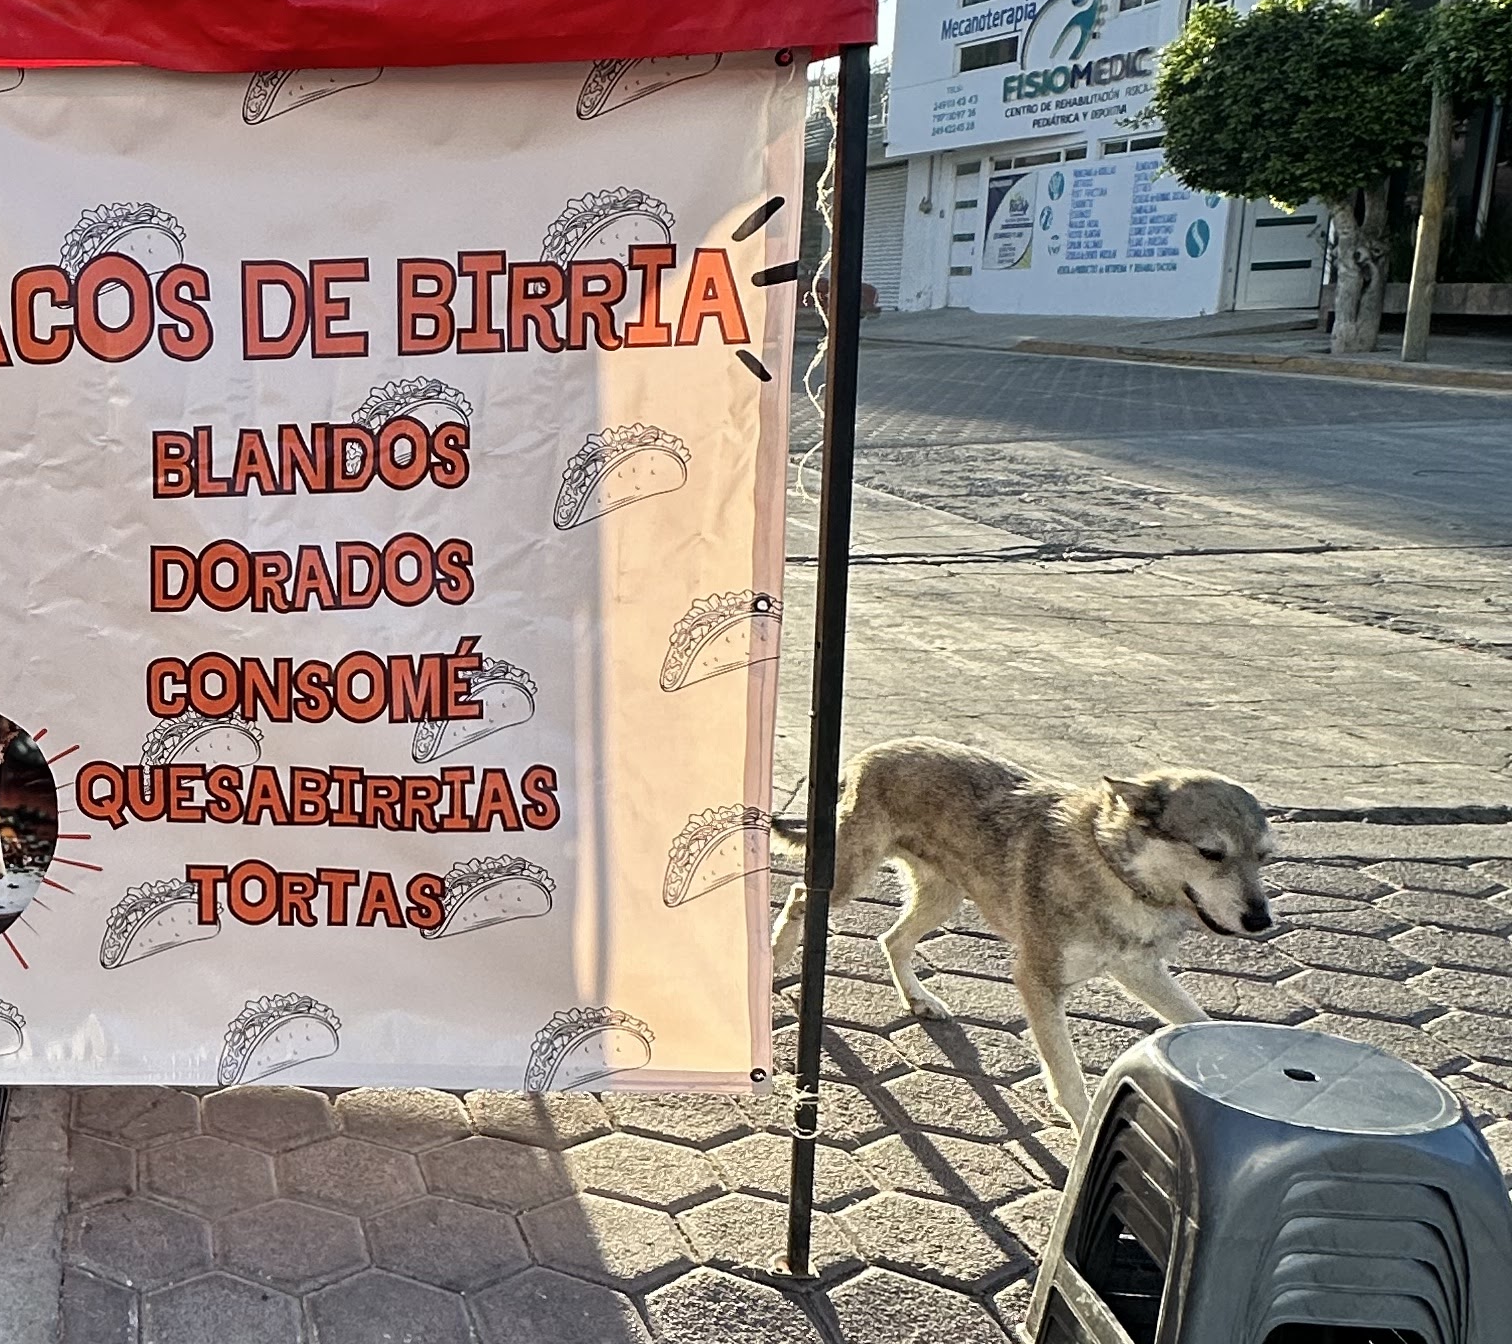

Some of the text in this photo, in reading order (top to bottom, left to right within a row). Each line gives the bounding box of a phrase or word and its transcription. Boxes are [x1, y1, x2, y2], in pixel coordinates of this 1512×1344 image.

[1002, 46, 1154, 103] FISIOMEDIC
[1005, 104, 1038, 118] CENTRO
[1041, 100, 1052, 112] DE
[1082, 111, 1089, 121] Y
[240, 257, 372, 362] DE
[397, 243, 752, 355] BIRRIA
[152, 417, 471, 499] BLANDOS
[149, 531, 475, 614] DORADOS
[146, 636, 483, 724] CONSOMÉ
[74, 763, 560, 833] QUESABIRRIAS
[186, 859, 446, 929] TORTAS
